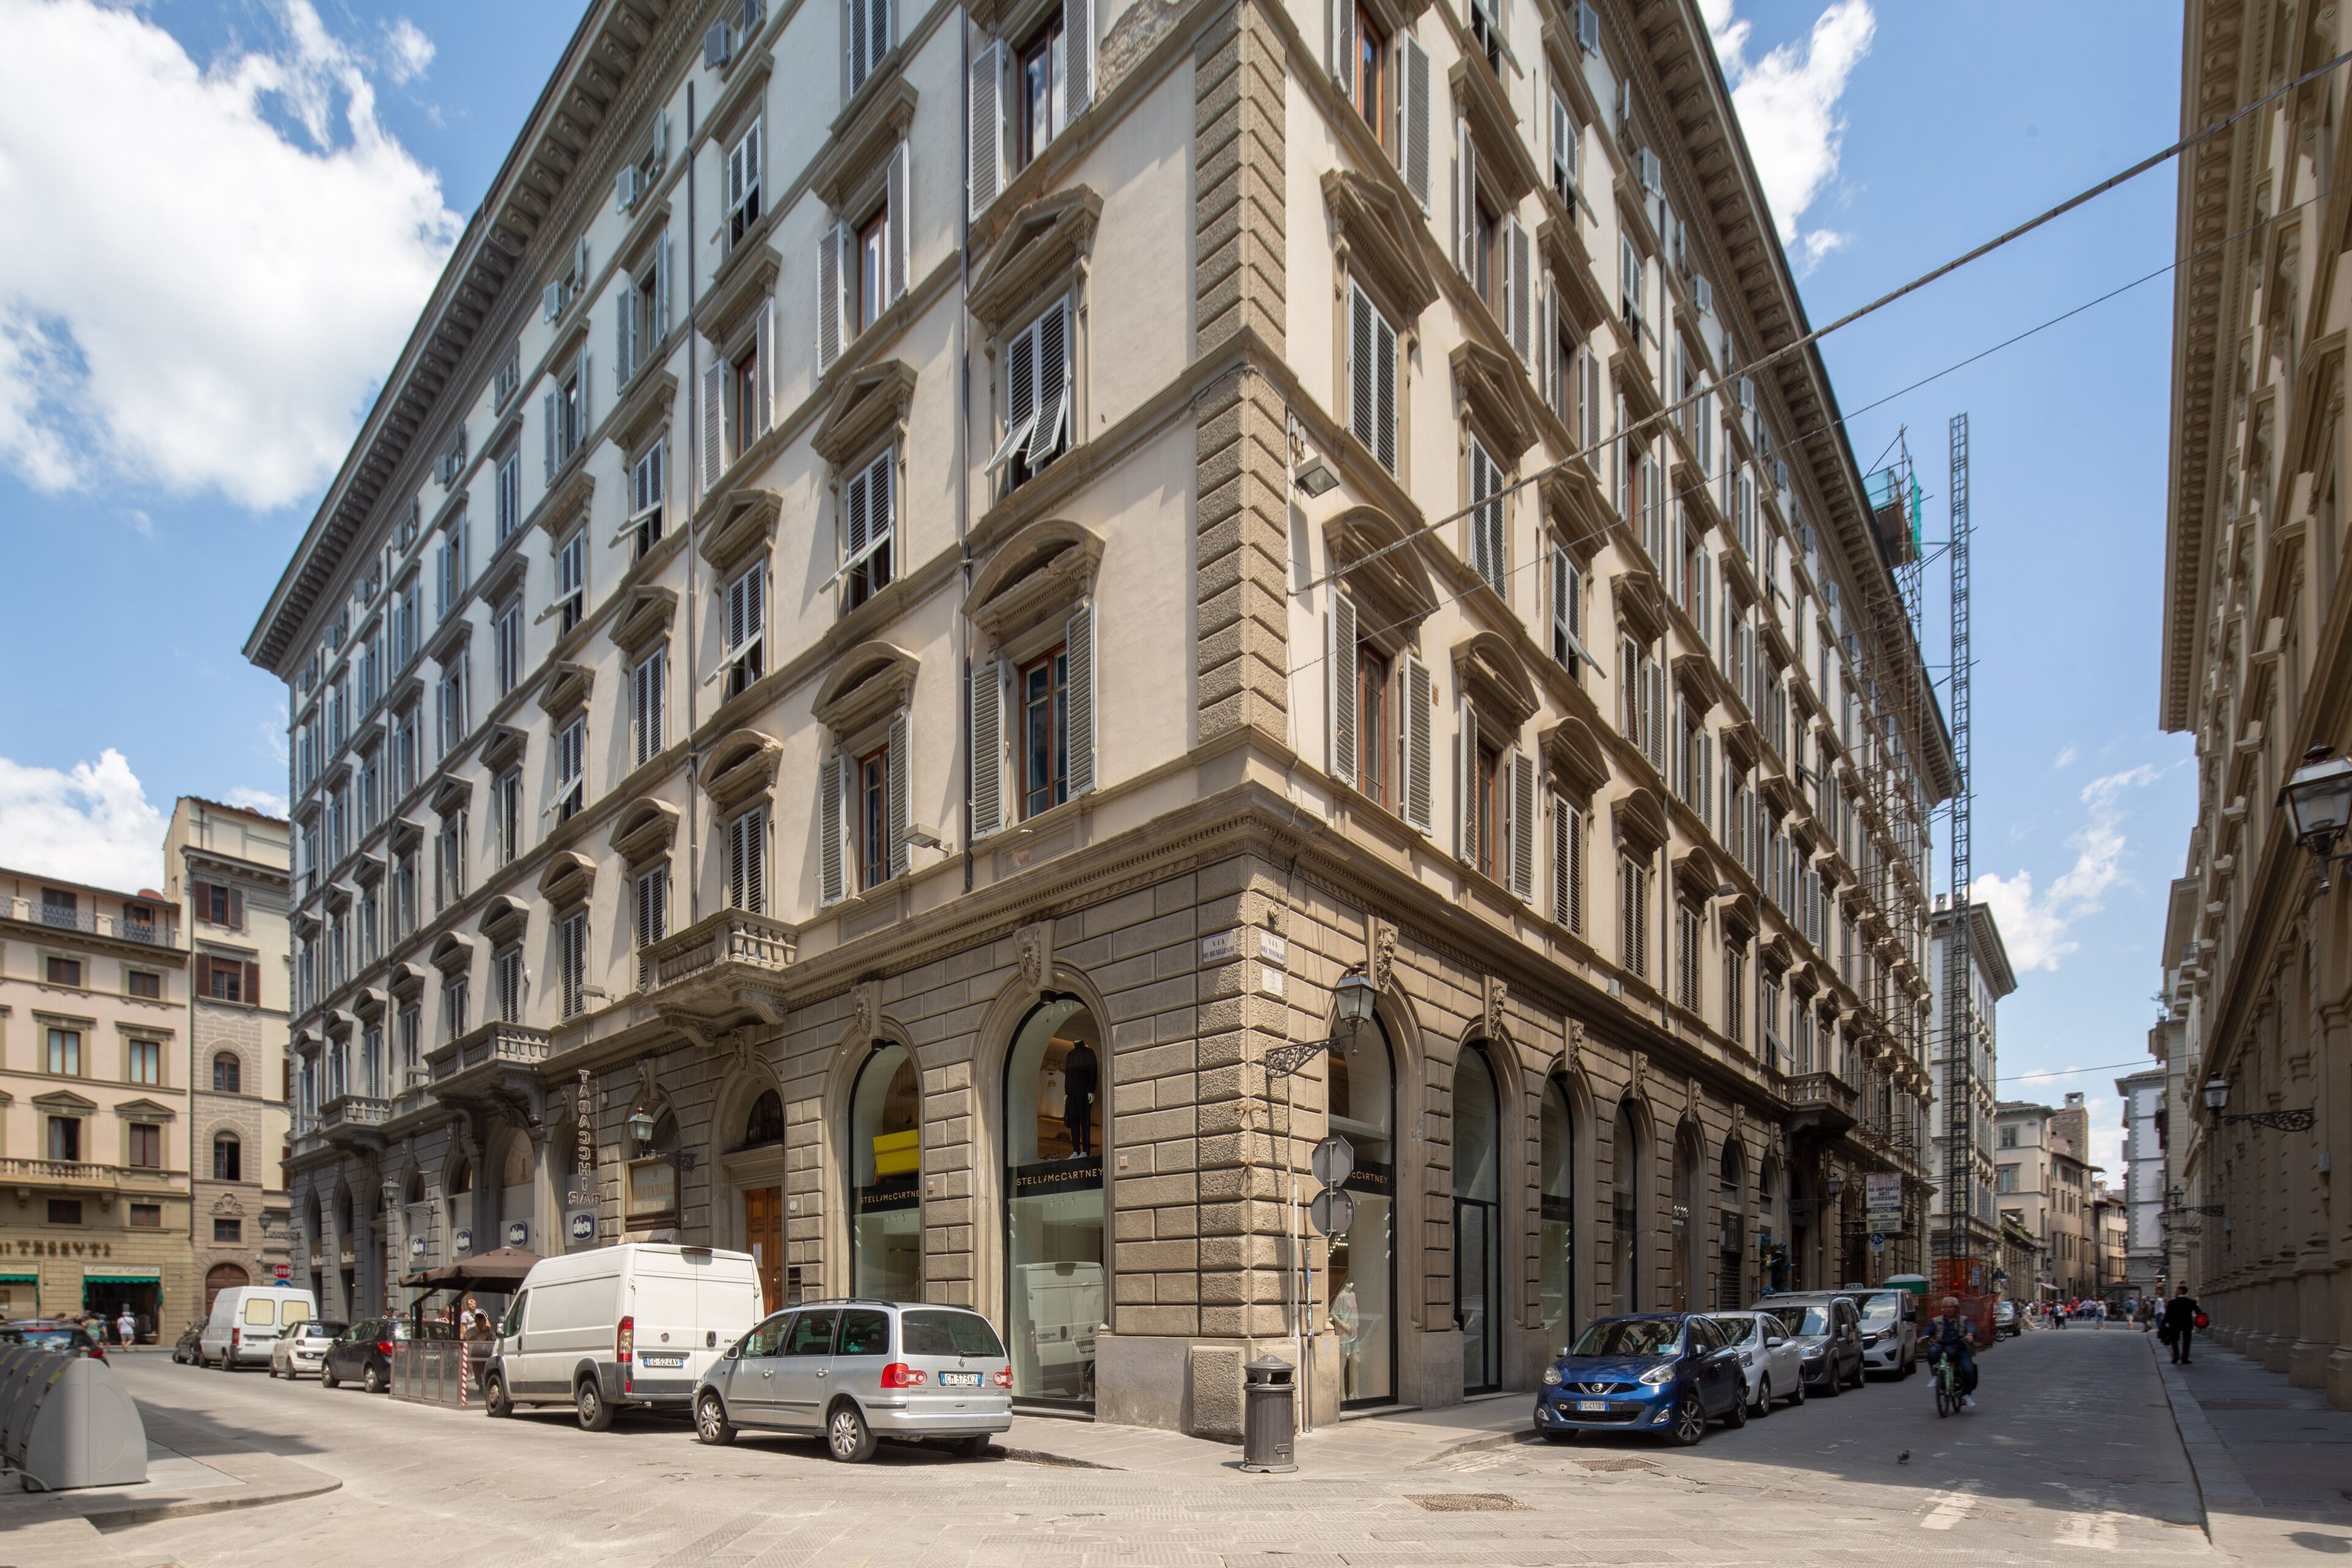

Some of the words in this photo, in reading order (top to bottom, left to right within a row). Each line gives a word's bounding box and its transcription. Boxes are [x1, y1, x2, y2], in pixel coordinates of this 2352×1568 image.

[1212, 938, 1225, 947] VIA
[1268, 938, 1278, 948] VIA
[659, 1358, 679, 1366] 524AV
[946, 1374, 955, 1383] CM
[957, 1374, 977, 1384] 373KZ
